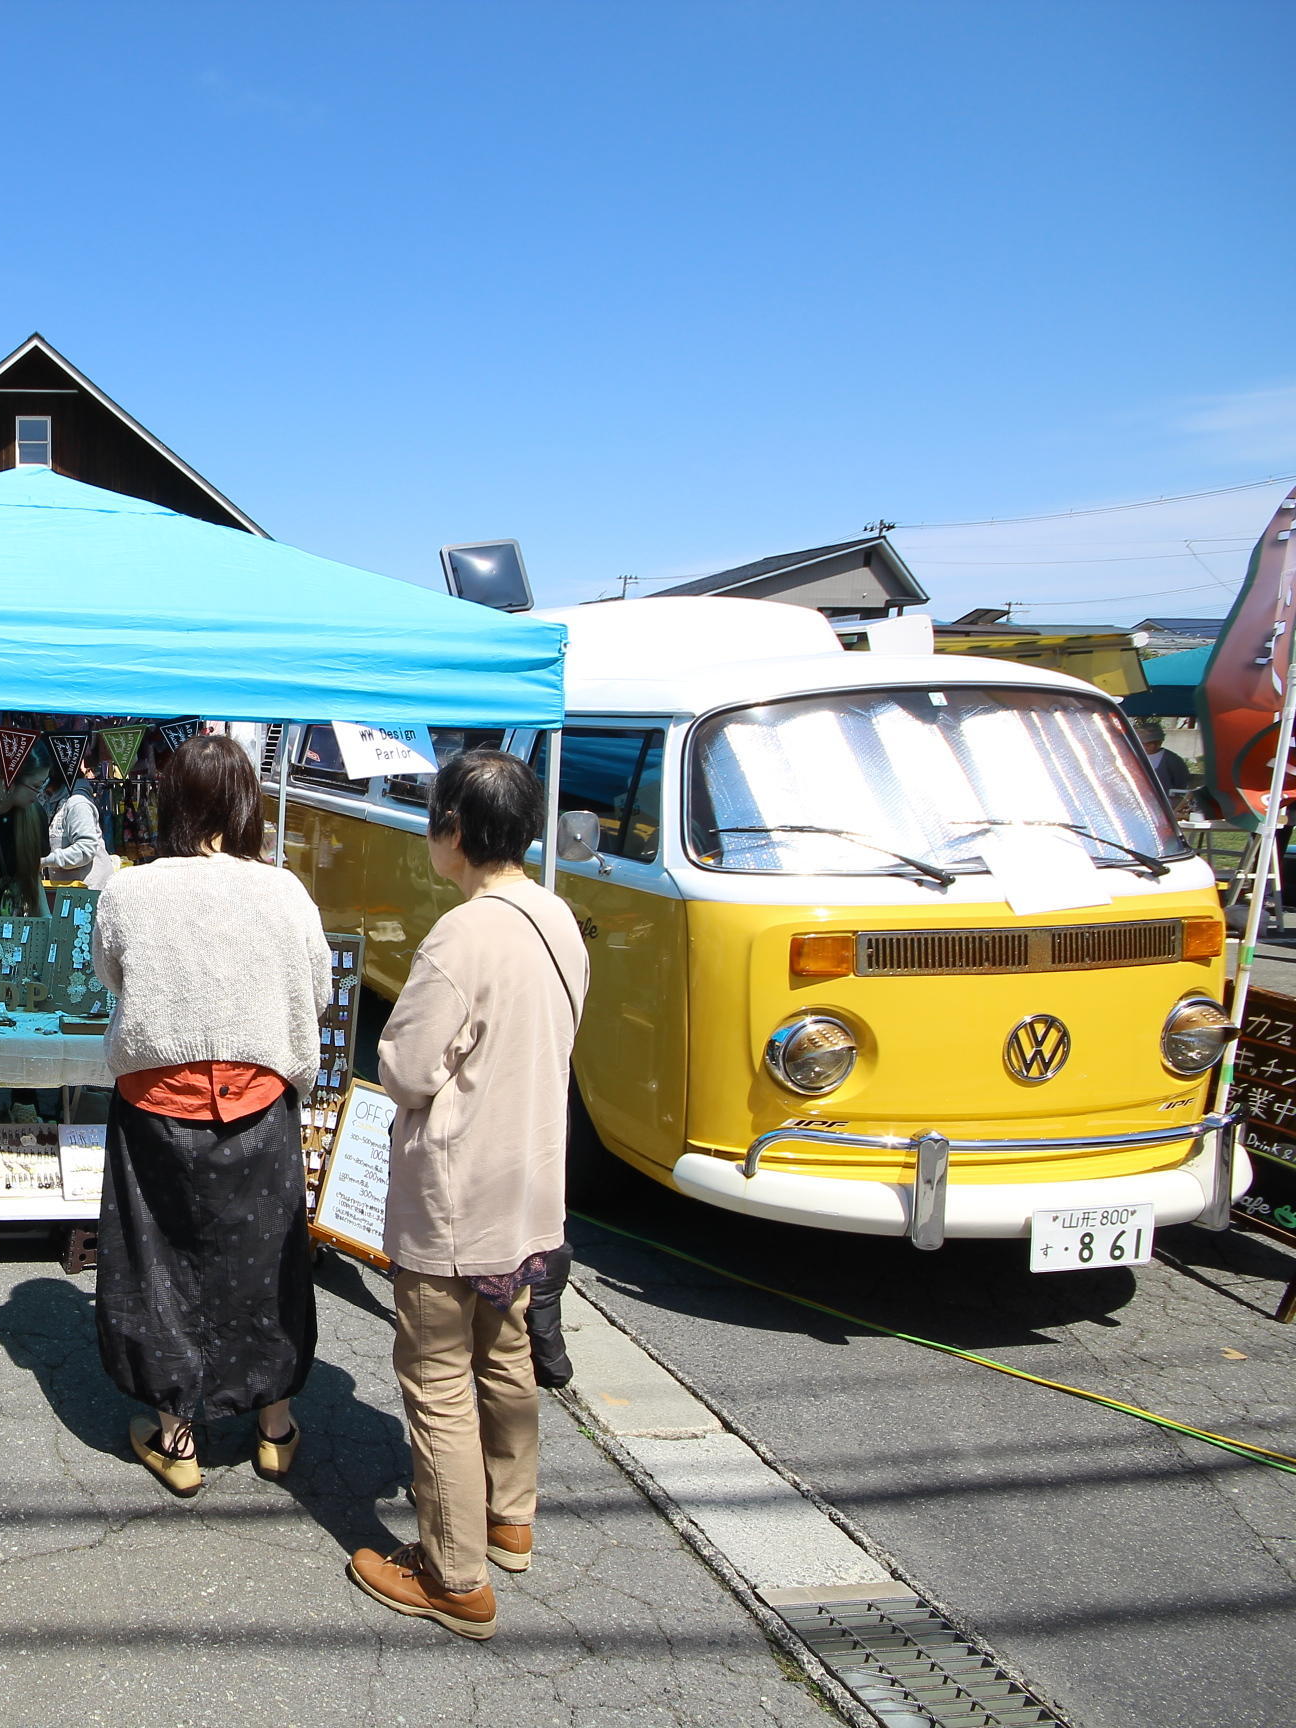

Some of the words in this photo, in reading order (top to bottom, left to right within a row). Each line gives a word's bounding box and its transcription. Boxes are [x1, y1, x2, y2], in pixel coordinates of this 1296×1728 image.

[359, 729, 374, 742] WW
[379, 727, 416, 741] Design
[9, 737, 27, 772] ADVENTURE
[67, 739, 80, 776] ADVENTURE
[375, 747, 411, 760] Parlor
[576, 916, 599, 942] afe
[1246, 1014, 1294, 1046] カフェ
[355, 1101, 383, 1123] OFF
[793, 1119, 850, 1128] IPF
[1246, 1133, 1282, 1155] Drink
[1241, 1195, 1272, 1215] afe
[1062, 1211, 1097, 1229] 山形
[1099, 1208, 1130, 1226] 800
[1039, 1243, 1054, 1259] す
